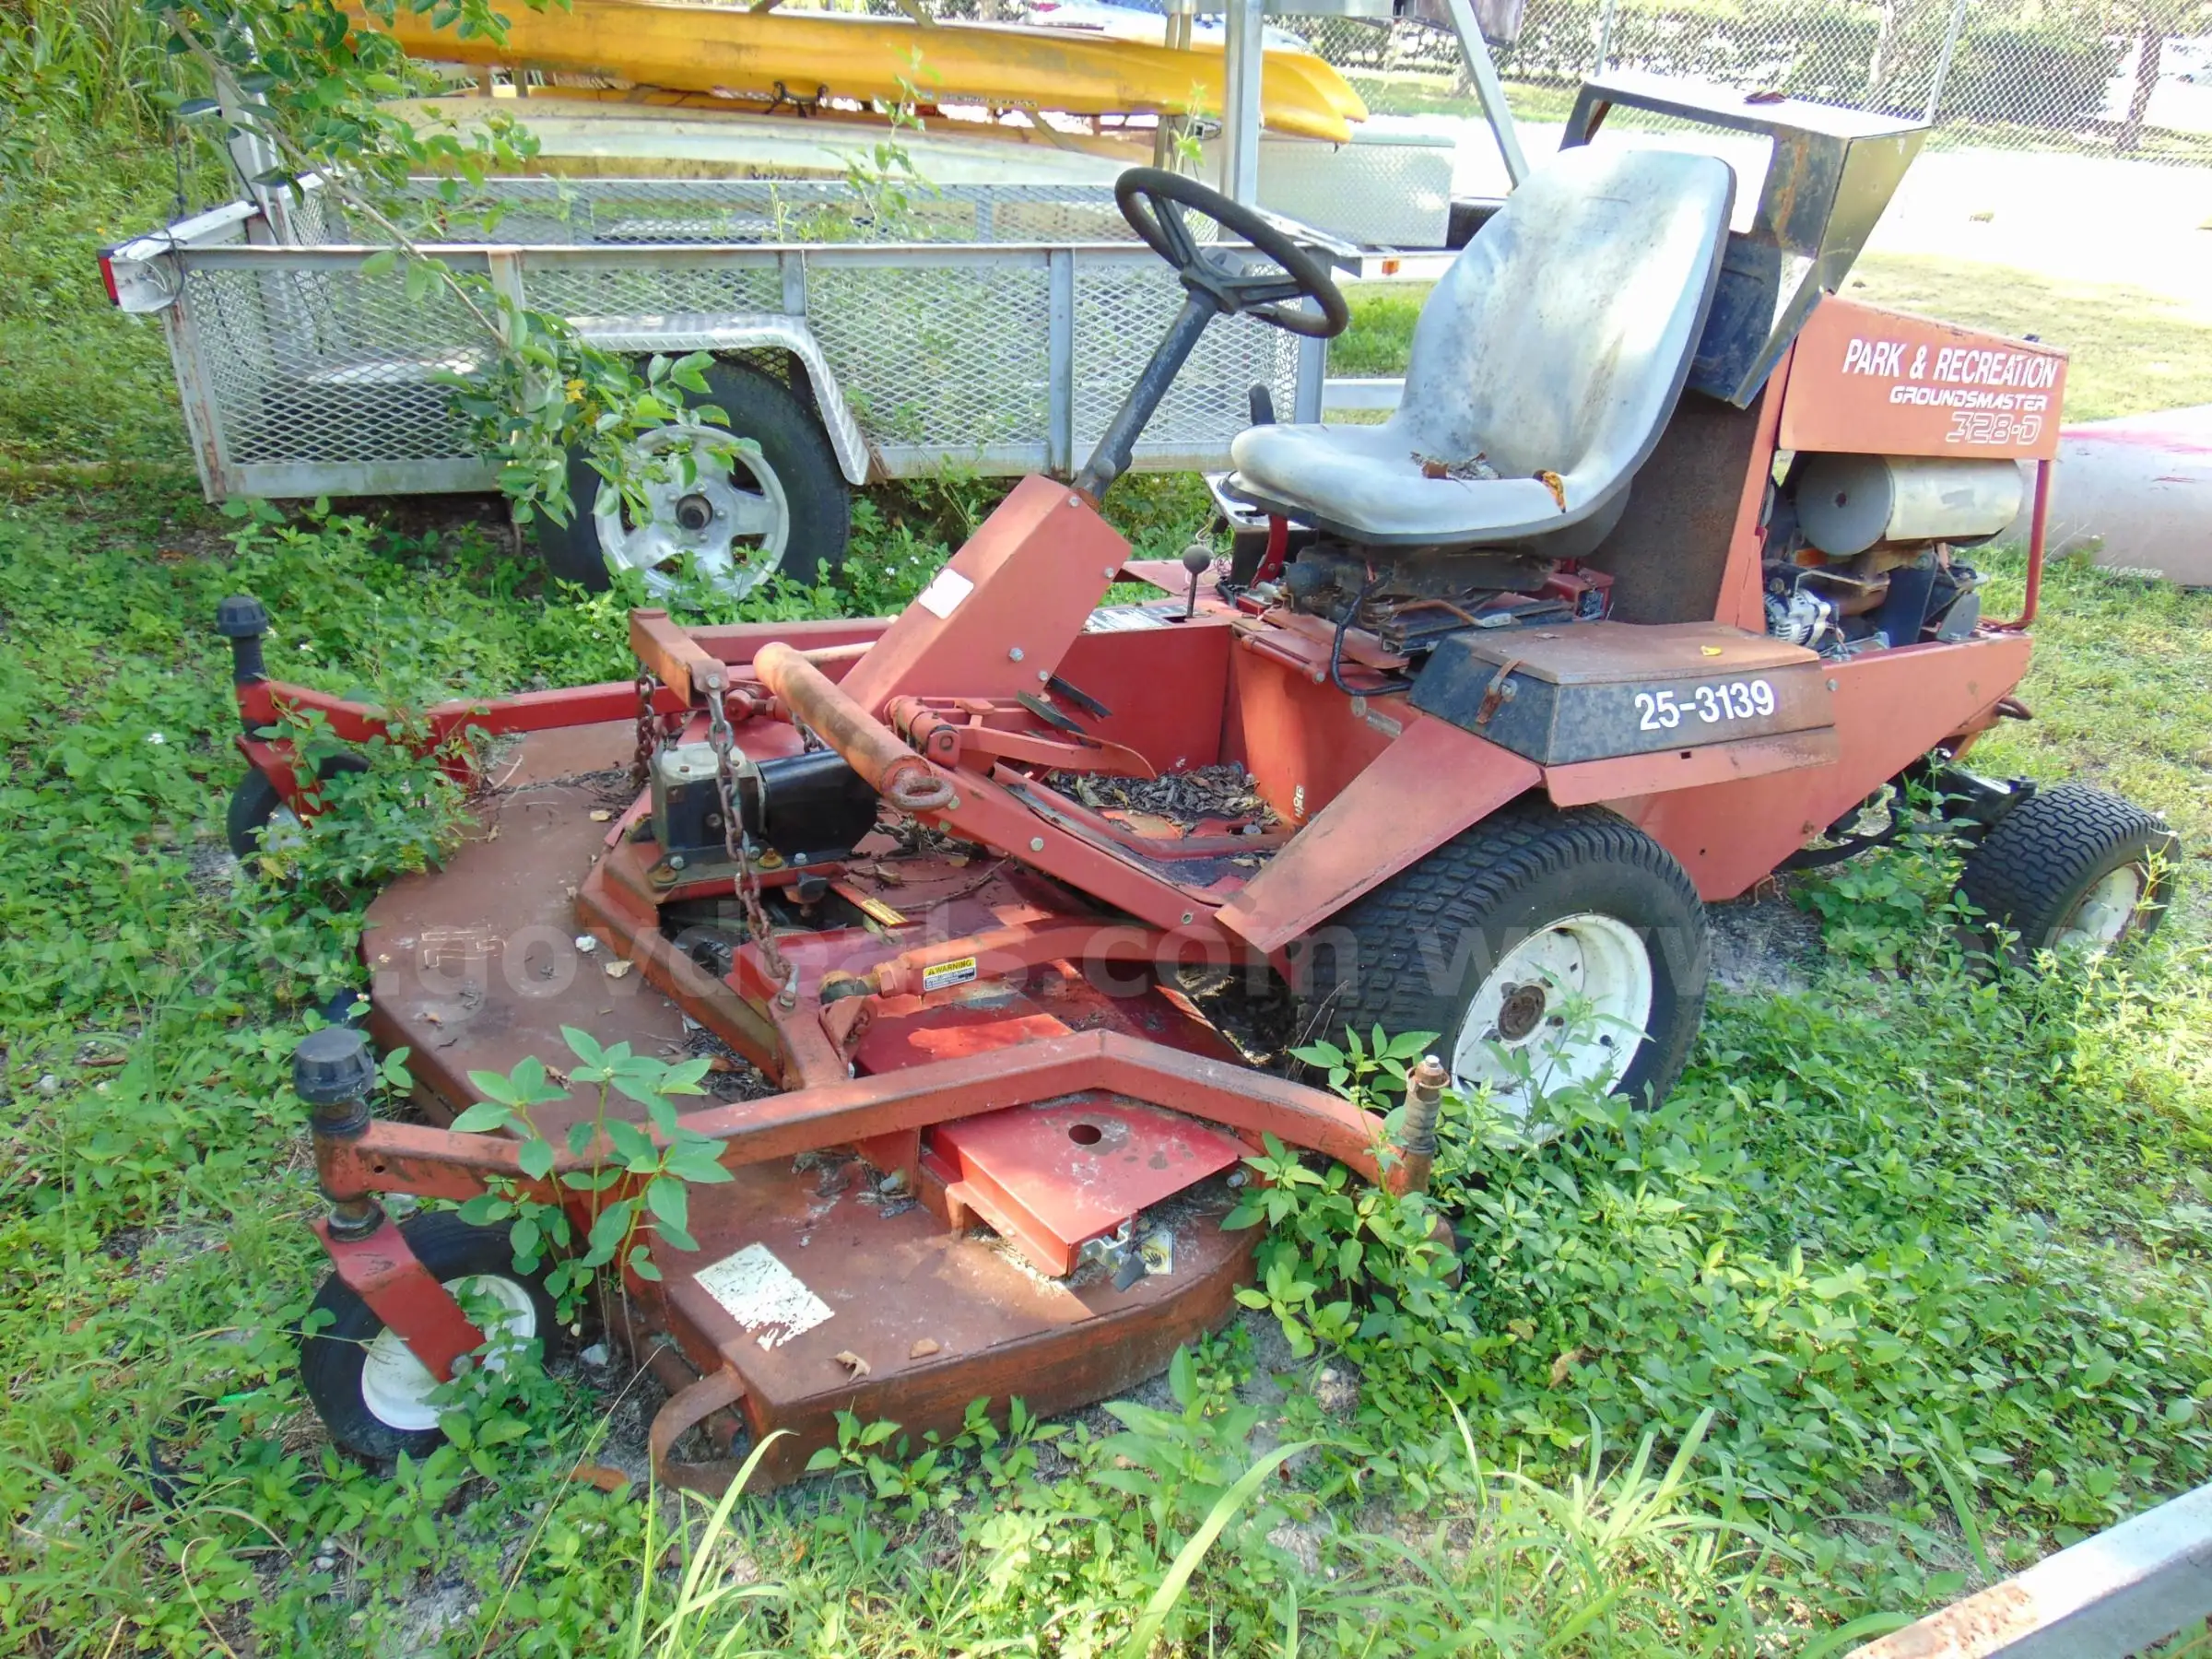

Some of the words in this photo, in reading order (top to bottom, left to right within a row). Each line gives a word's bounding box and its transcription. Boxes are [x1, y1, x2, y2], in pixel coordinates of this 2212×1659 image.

[1843, 337, 1907, 378] PARK
[1909, 344, 1928, 380] &
[1932, 347, 2058, 388] RECREATION
[1889, 385, 2048, 411] GROUNDSMASTER
[1945, 411, 2041, 445] 328-D
[1634, 679, 1775, 731] 25-3139
[935, 959, 972, 974] WARNING
